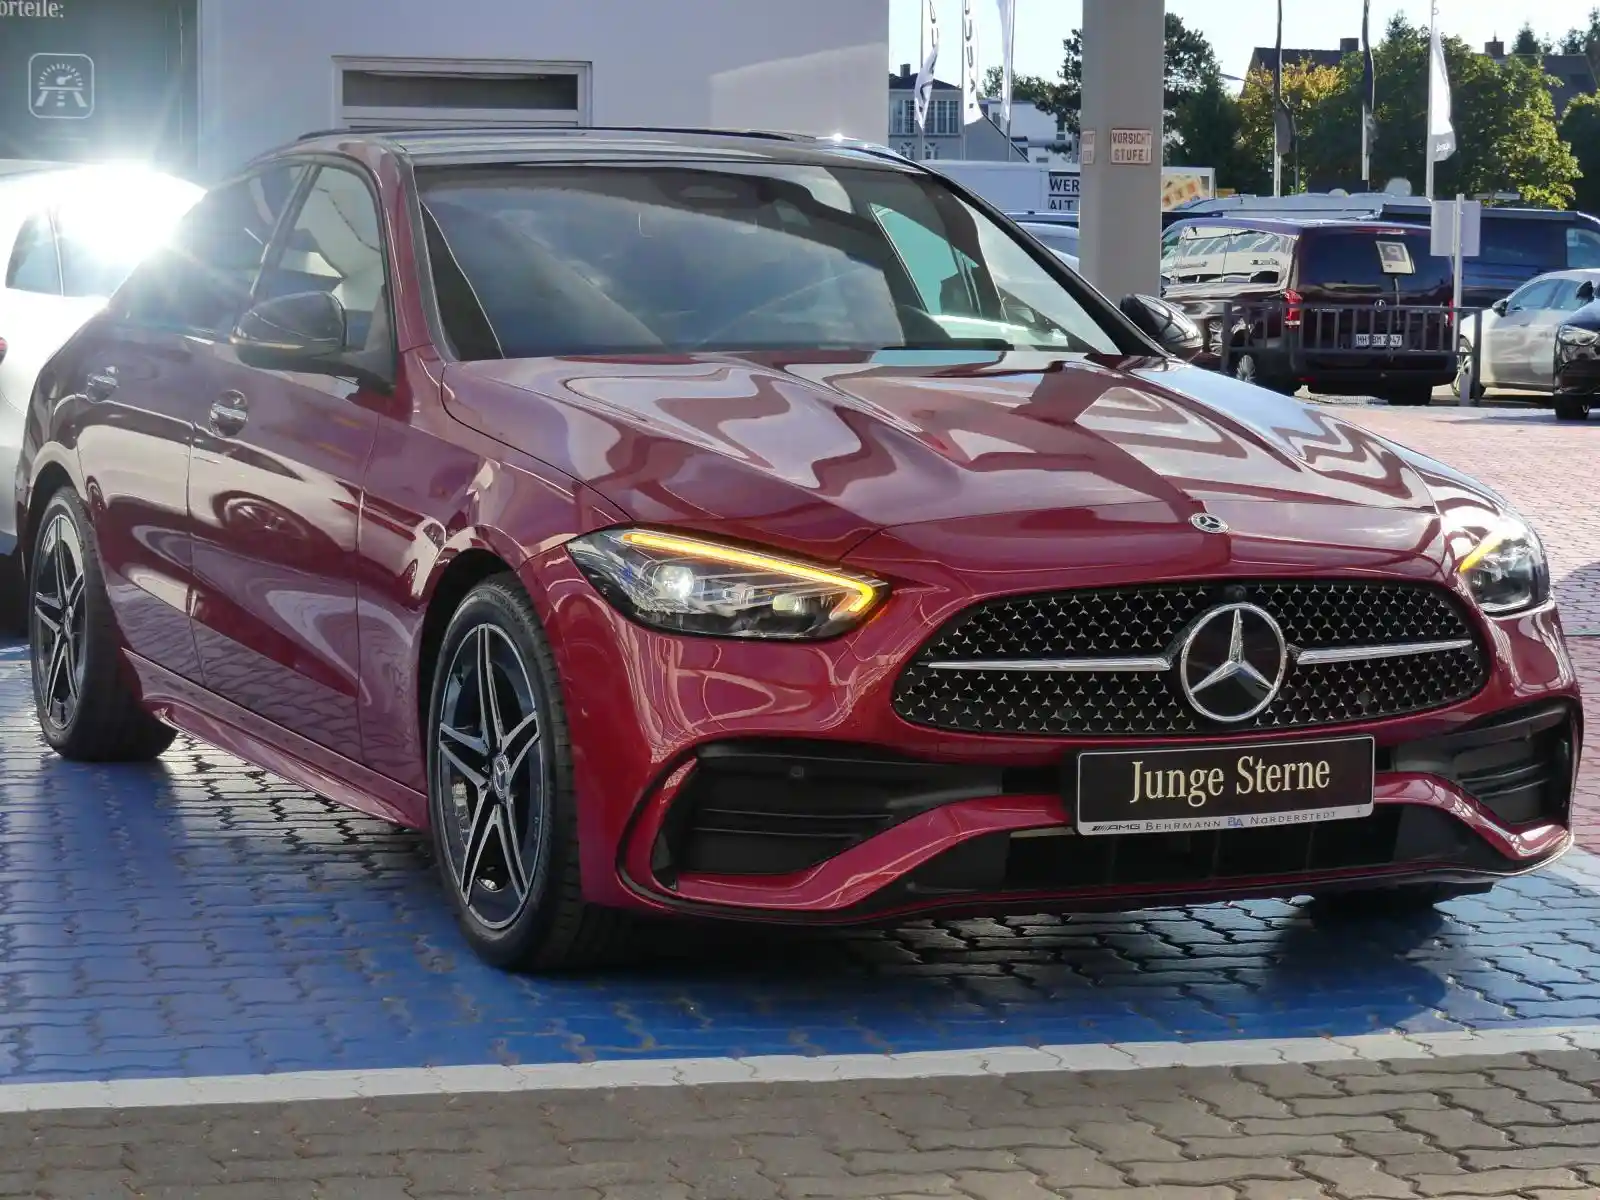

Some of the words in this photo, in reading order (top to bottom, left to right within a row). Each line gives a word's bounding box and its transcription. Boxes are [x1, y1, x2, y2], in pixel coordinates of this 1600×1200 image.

[1112, 132, 1151, 145] VORSICHT
[1129, 760, 1225, 808] Junge
[1236, 755, 1331, 795] Sterne
[1104, 823, 1141, 832] AMG
[1145, 821, 1221, 831] BEHRMANN
